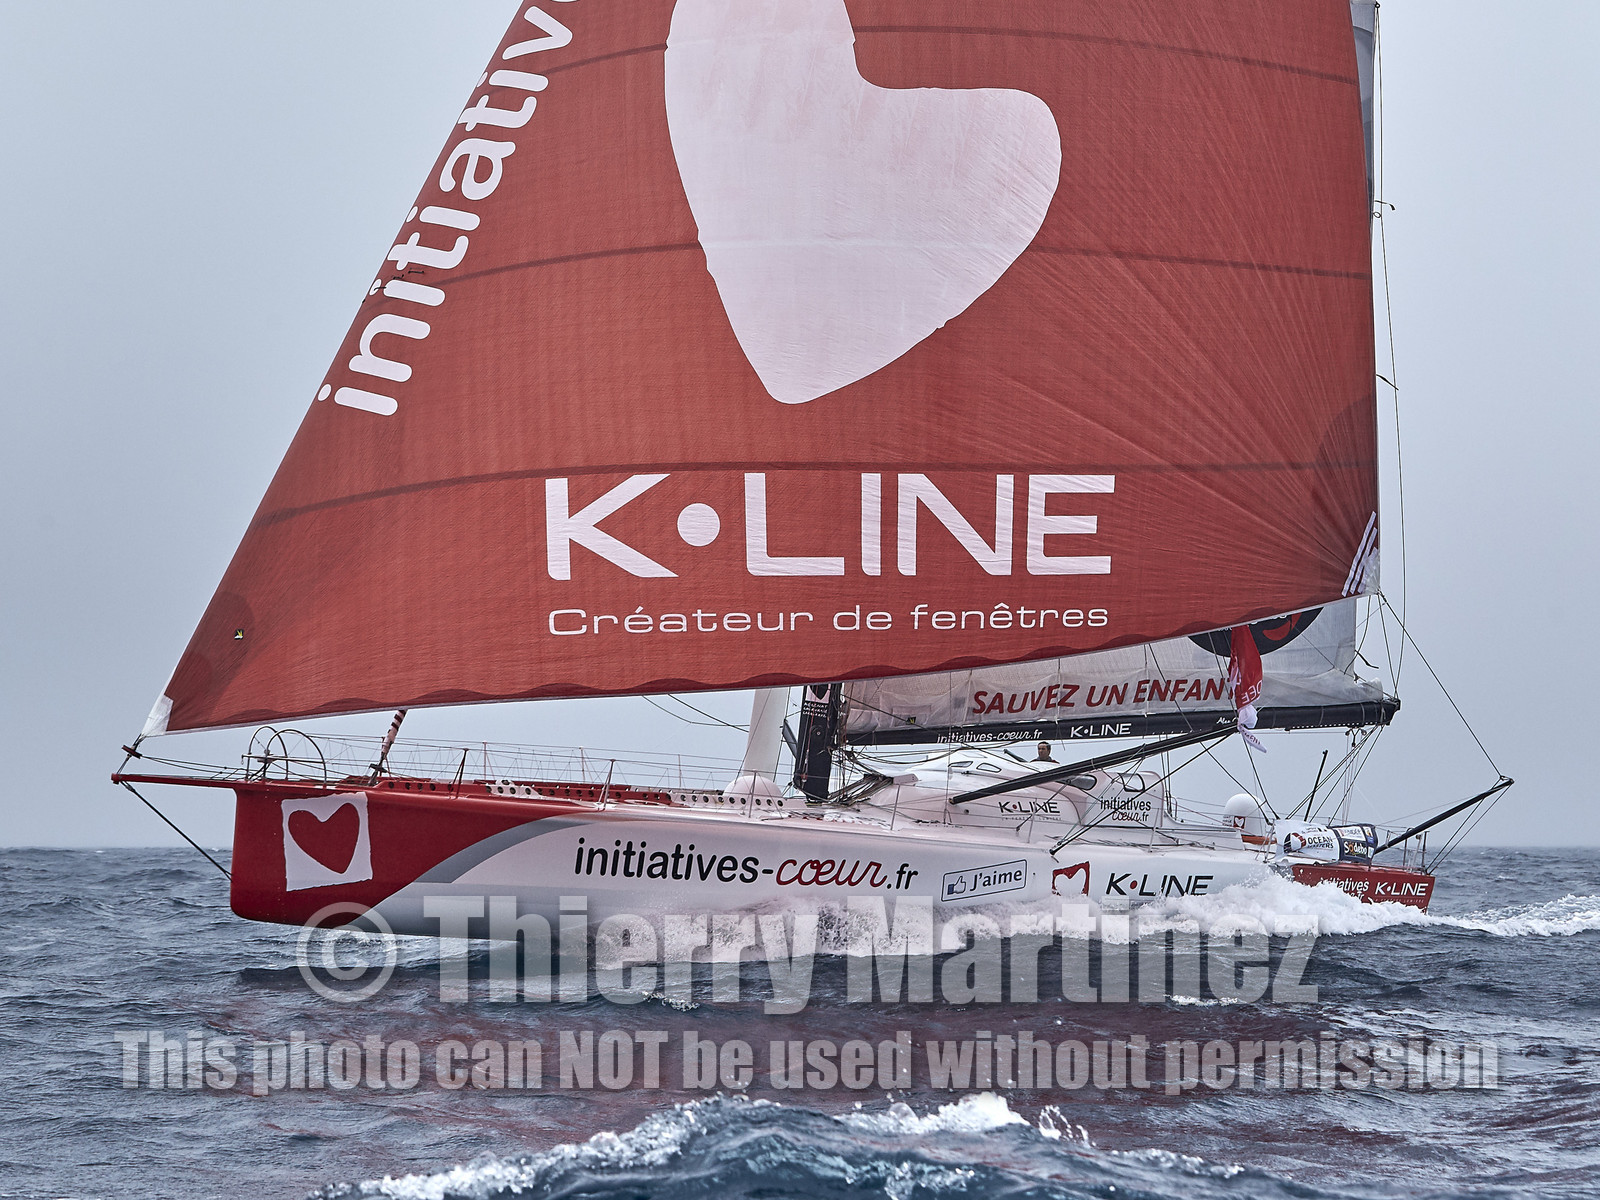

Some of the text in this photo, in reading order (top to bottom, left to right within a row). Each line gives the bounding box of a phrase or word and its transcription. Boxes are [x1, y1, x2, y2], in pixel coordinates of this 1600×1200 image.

[547, 601, 1110, 636] Créateur de fenêtres
[972, 683, 1081, 715] SAUVEZ
[1085, 682, 1129, 707] UN
[1100, 796, 1152, 811] initiatives
